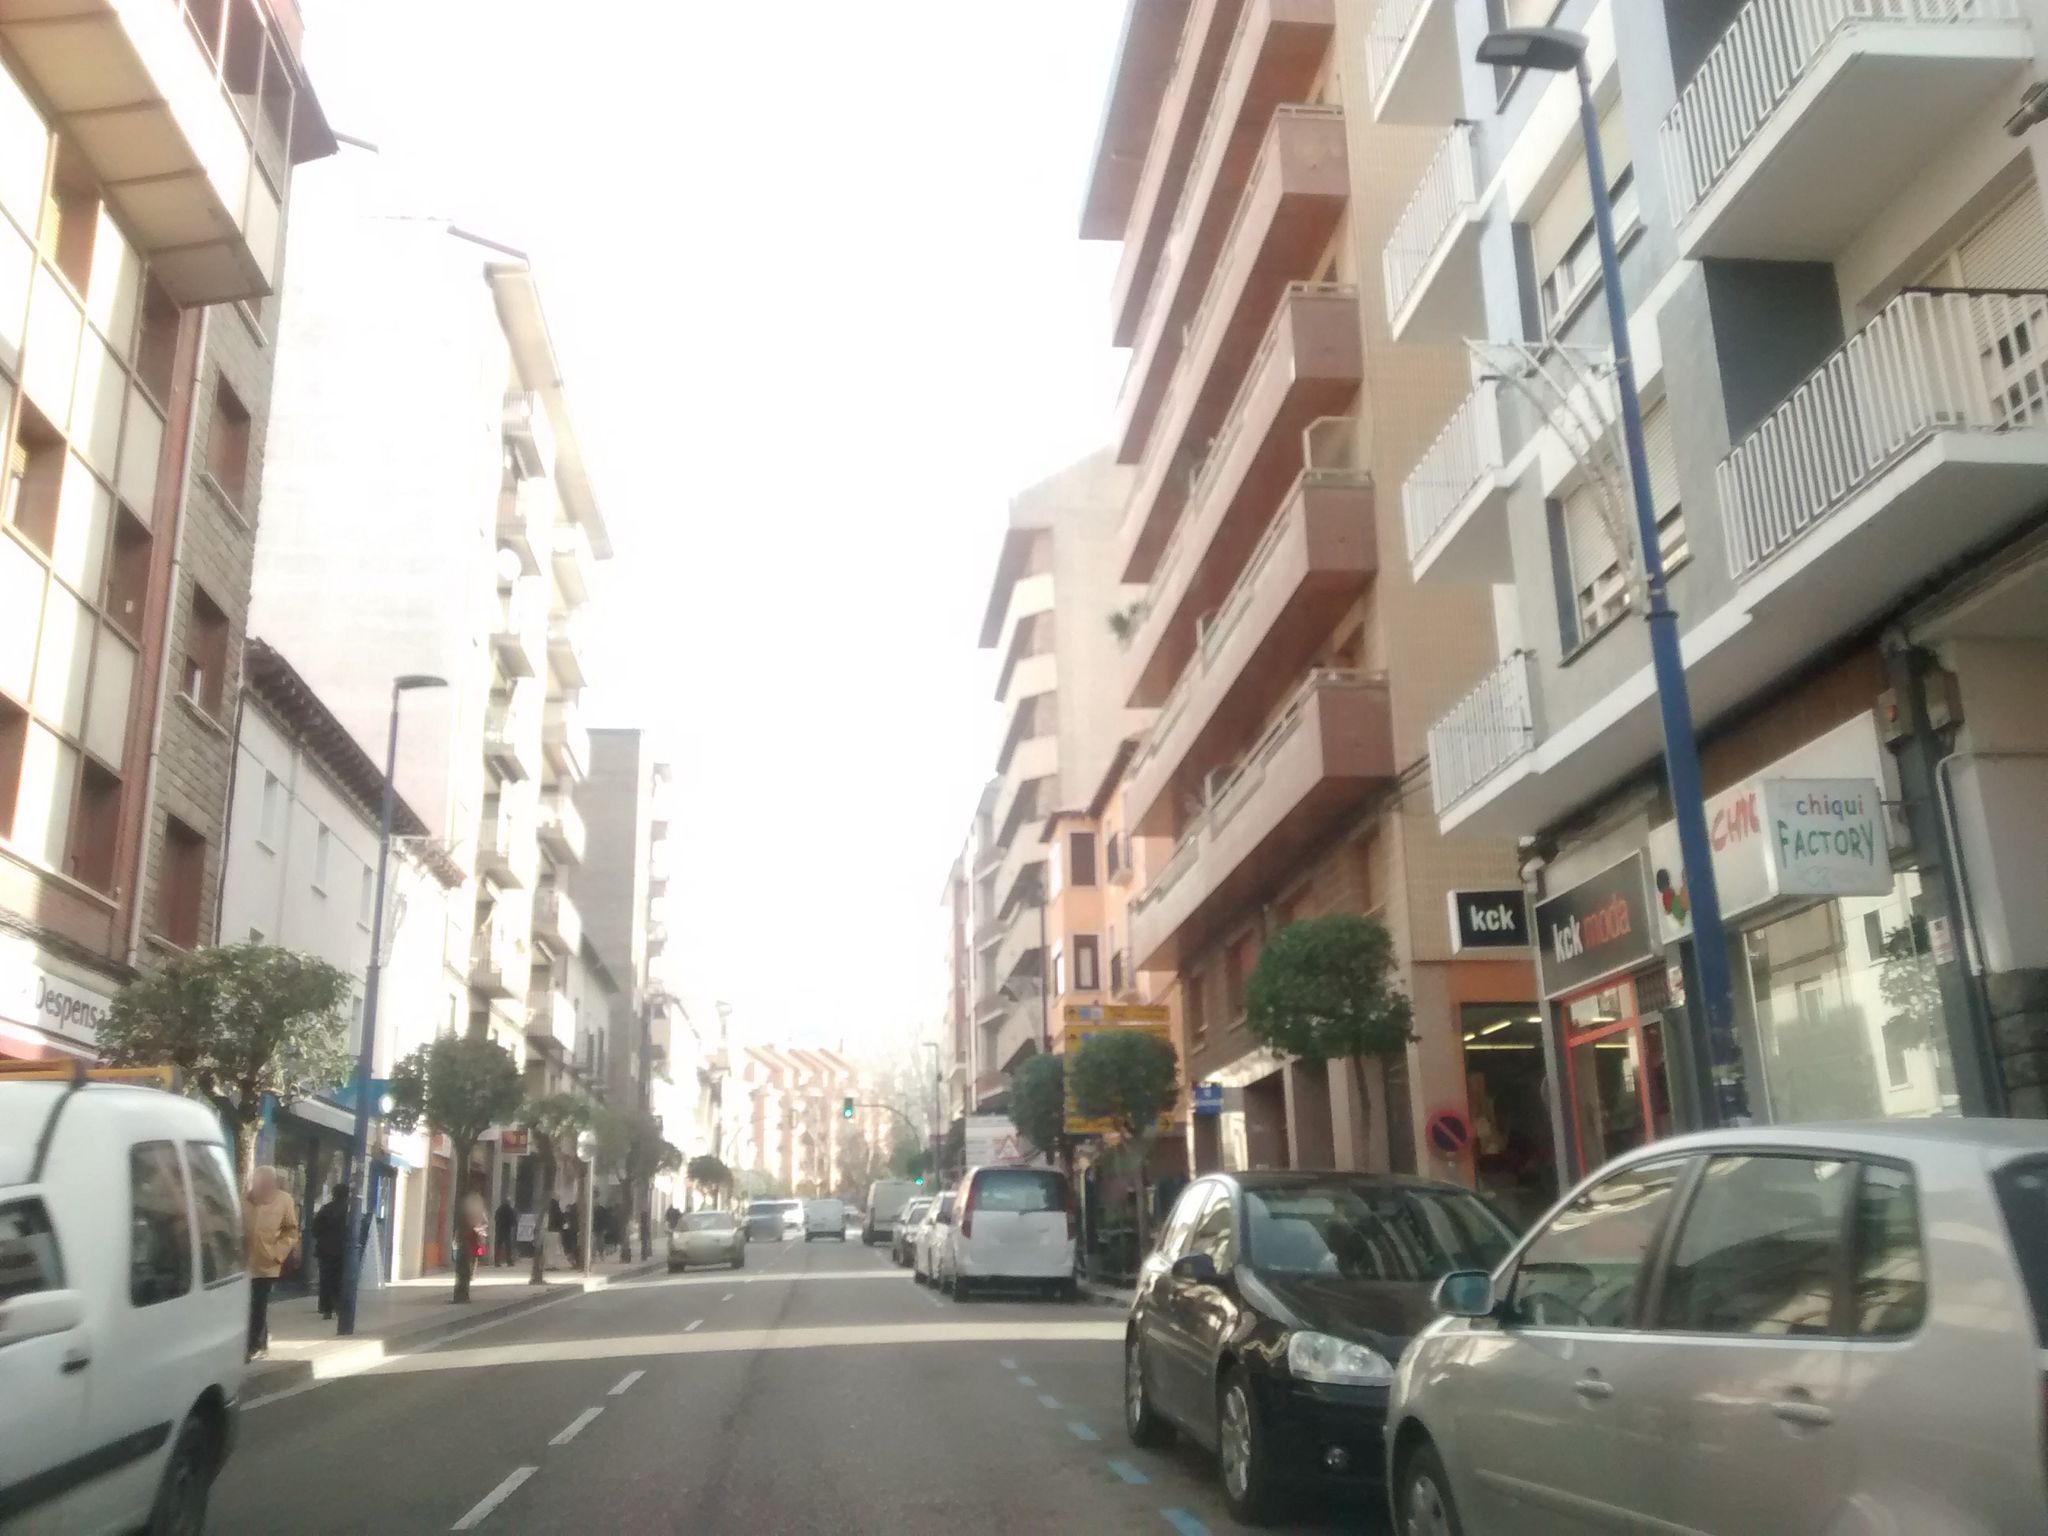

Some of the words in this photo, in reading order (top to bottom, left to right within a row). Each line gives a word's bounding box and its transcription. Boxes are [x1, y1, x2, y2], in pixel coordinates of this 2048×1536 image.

[1796, 793, 1865, 821] chiqui
[1776, 818, 1874, 868] FACTORY
[1470, 904, 1516, 932] kck
[1552, 914, 1584, 963] kck
[1583, 893, 1632, 949] moda
